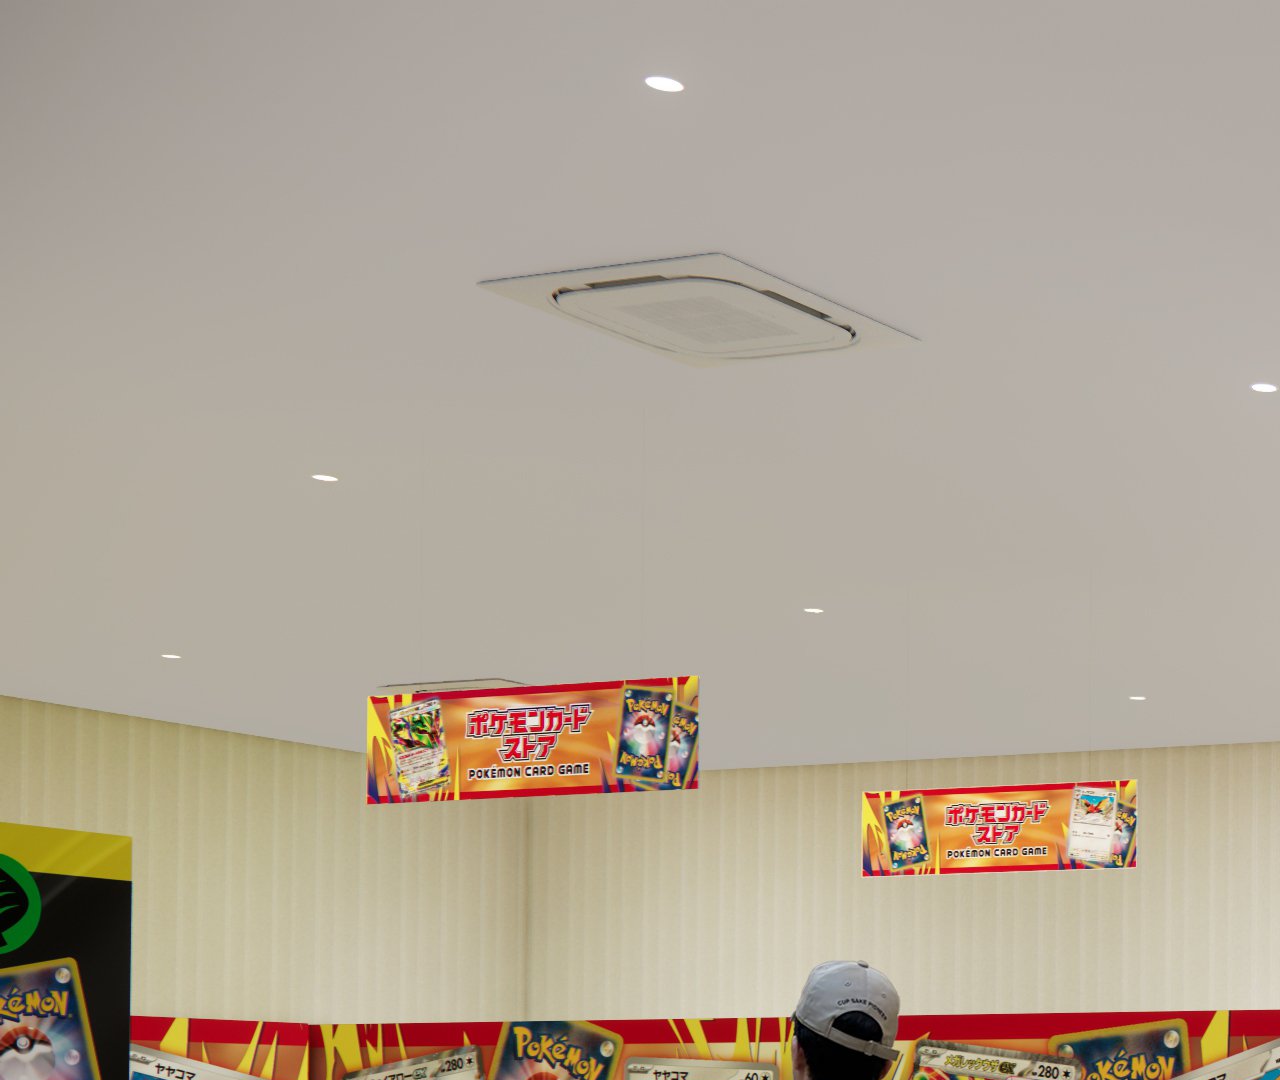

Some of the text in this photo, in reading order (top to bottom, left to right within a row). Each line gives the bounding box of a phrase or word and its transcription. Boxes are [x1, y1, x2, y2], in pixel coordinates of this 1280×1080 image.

[467, 703, 592, 737] ポケモンカード
[498, 734, 558, 763] ストア
[468, 763, 590, 780] POKÉMON CARD GAME
[945, 801, 1048, 826] ポケモンカード
[971, 824, 1021, 845] ストア
[947, 847, 1048, 858] POKÉMON CARD GAME
[445, 1058, 464, 1071] 280
[1038, 1065, 1060, 1080] 280
[653, 1070, 689, 1080] ヤヤコマ
